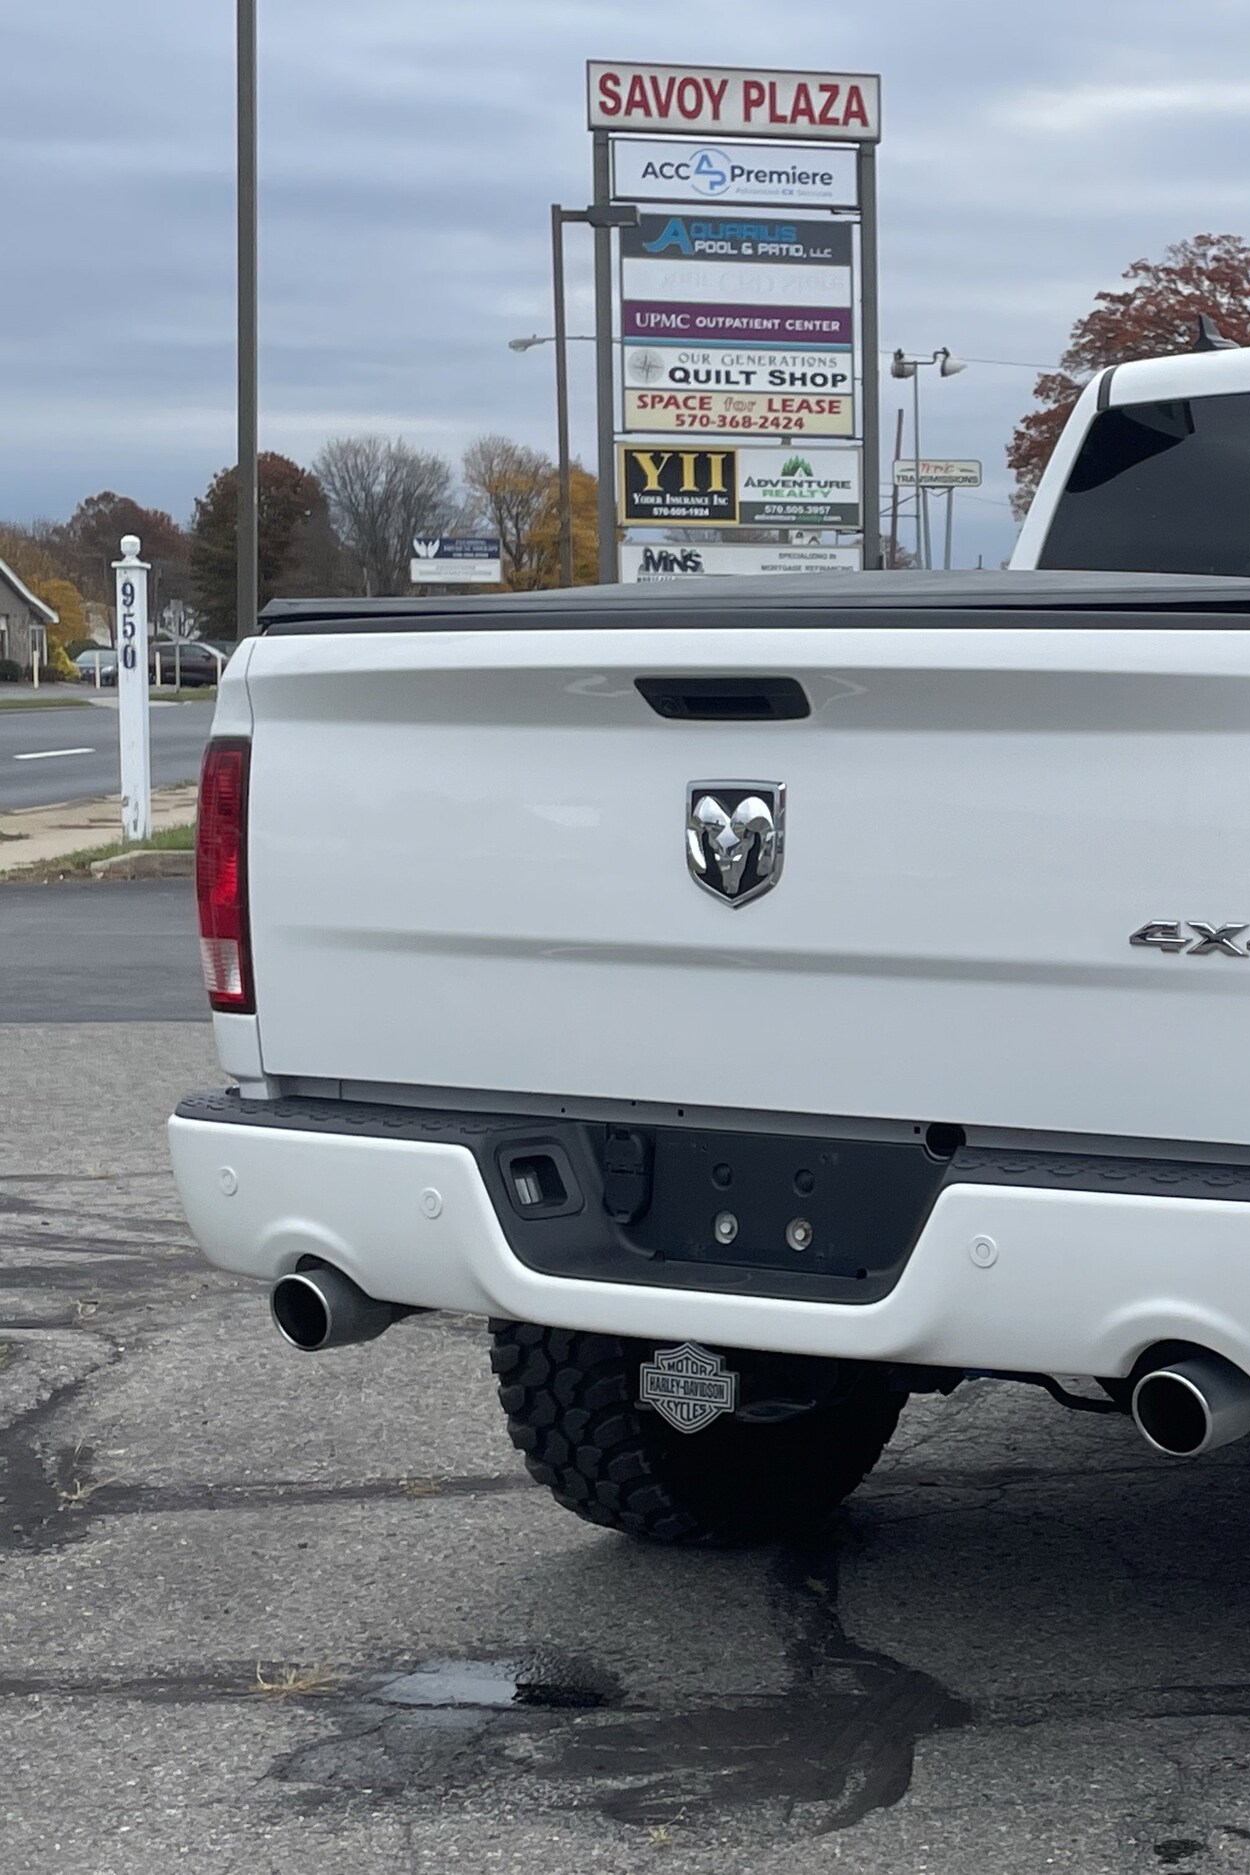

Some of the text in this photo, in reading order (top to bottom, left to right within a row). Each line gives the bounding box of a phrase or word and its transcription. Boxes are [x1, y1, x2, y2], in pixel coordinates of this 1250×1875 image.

[598, 72, 869, 128] SAVOY PLAZA
[641, 161, 691, 181] ACC
[730, 164, 833, 186] Premiere
[641, 217, 798, 256] AQUARIUS
[694, 240, 737, 254] POOL
[741, 242, 753, 255] &
[809, 247, 833, 258] LLC
[635, 311, 841, 332] UPMC OUTPATIENT CENTER
[678, 352, 838, 368] OUR GENERATIONS
[668, 366, 848, 388] QUILT SHOP
[636, 393, 842, 415] SPACE for LEASE
[675, 413, 806, 430] 570-368-2424
[632, 452, 728, 493] YII
[743, 476, 852, 490] ADVENTURE
[665, 493, 709, 506] INSURANCE
[713, 494, 729, 506] INC
[762, 488, 831, 499] REALTY
[122, 582, 136, 669] 950
[667, 1359, 708, 1376] MOTOR
[649, 1375, 726, 1400] HARLEY-DAVIDSON
[666, 1400, 707, 1421] CYCLES
